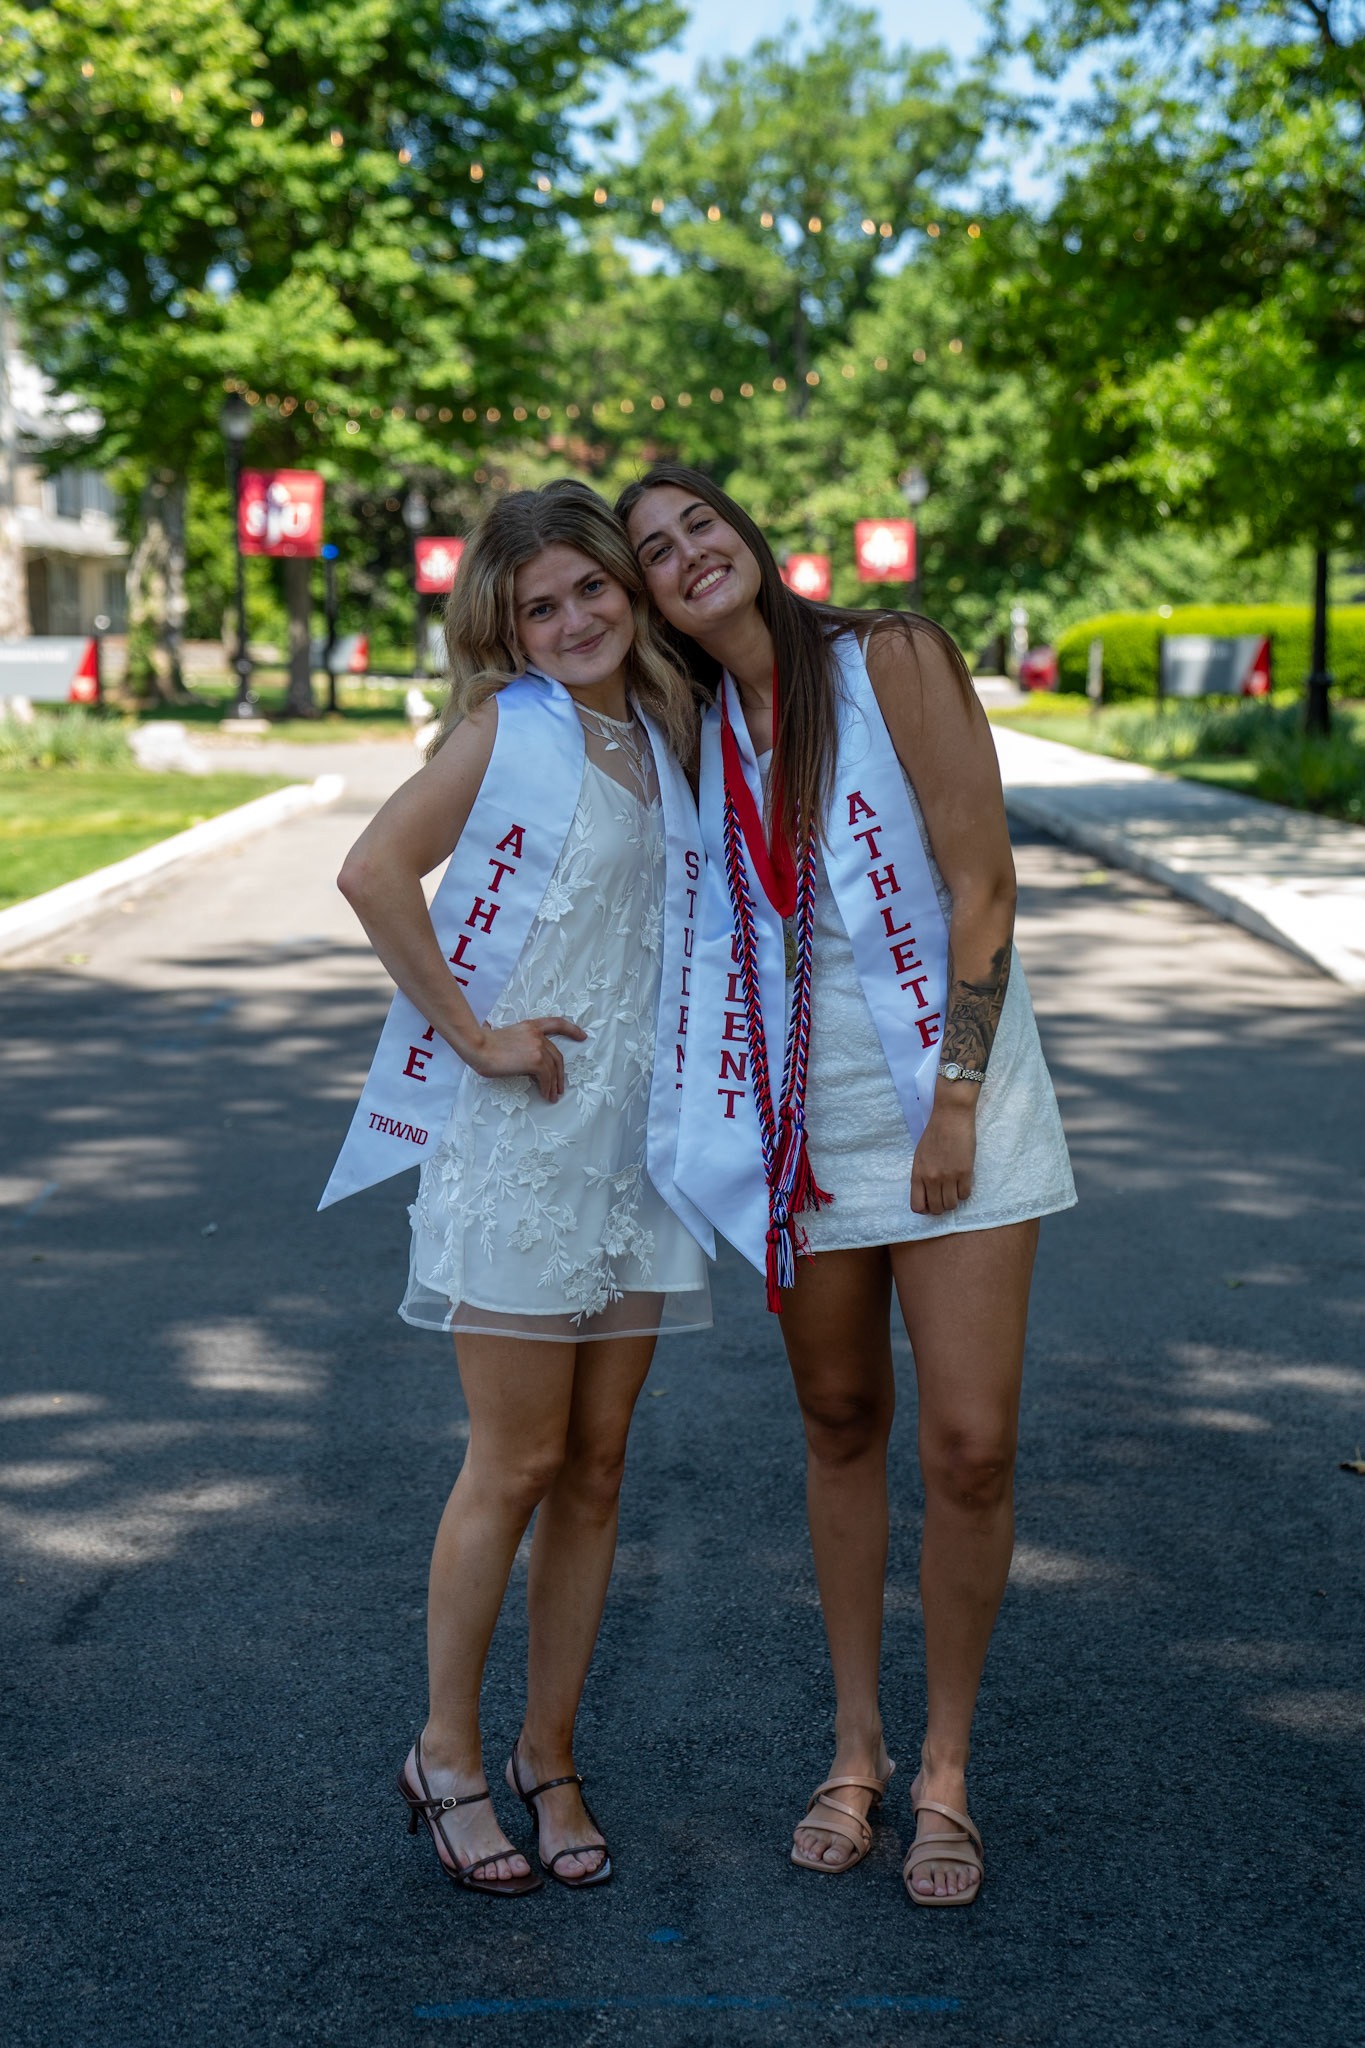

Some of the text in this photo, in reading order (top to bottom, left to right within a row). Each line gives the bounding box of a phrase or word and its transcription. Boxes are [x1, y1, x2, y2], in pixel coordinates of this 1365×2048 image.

[402, 824, 527, 1082] ATHLE
[676, 850, 699, 1113] STUDEN
[717, 870, 759, 1119] DENT
[847, 790, 941, 1049] ATHLETE
[369, 1112, 429, 1146] THWND
